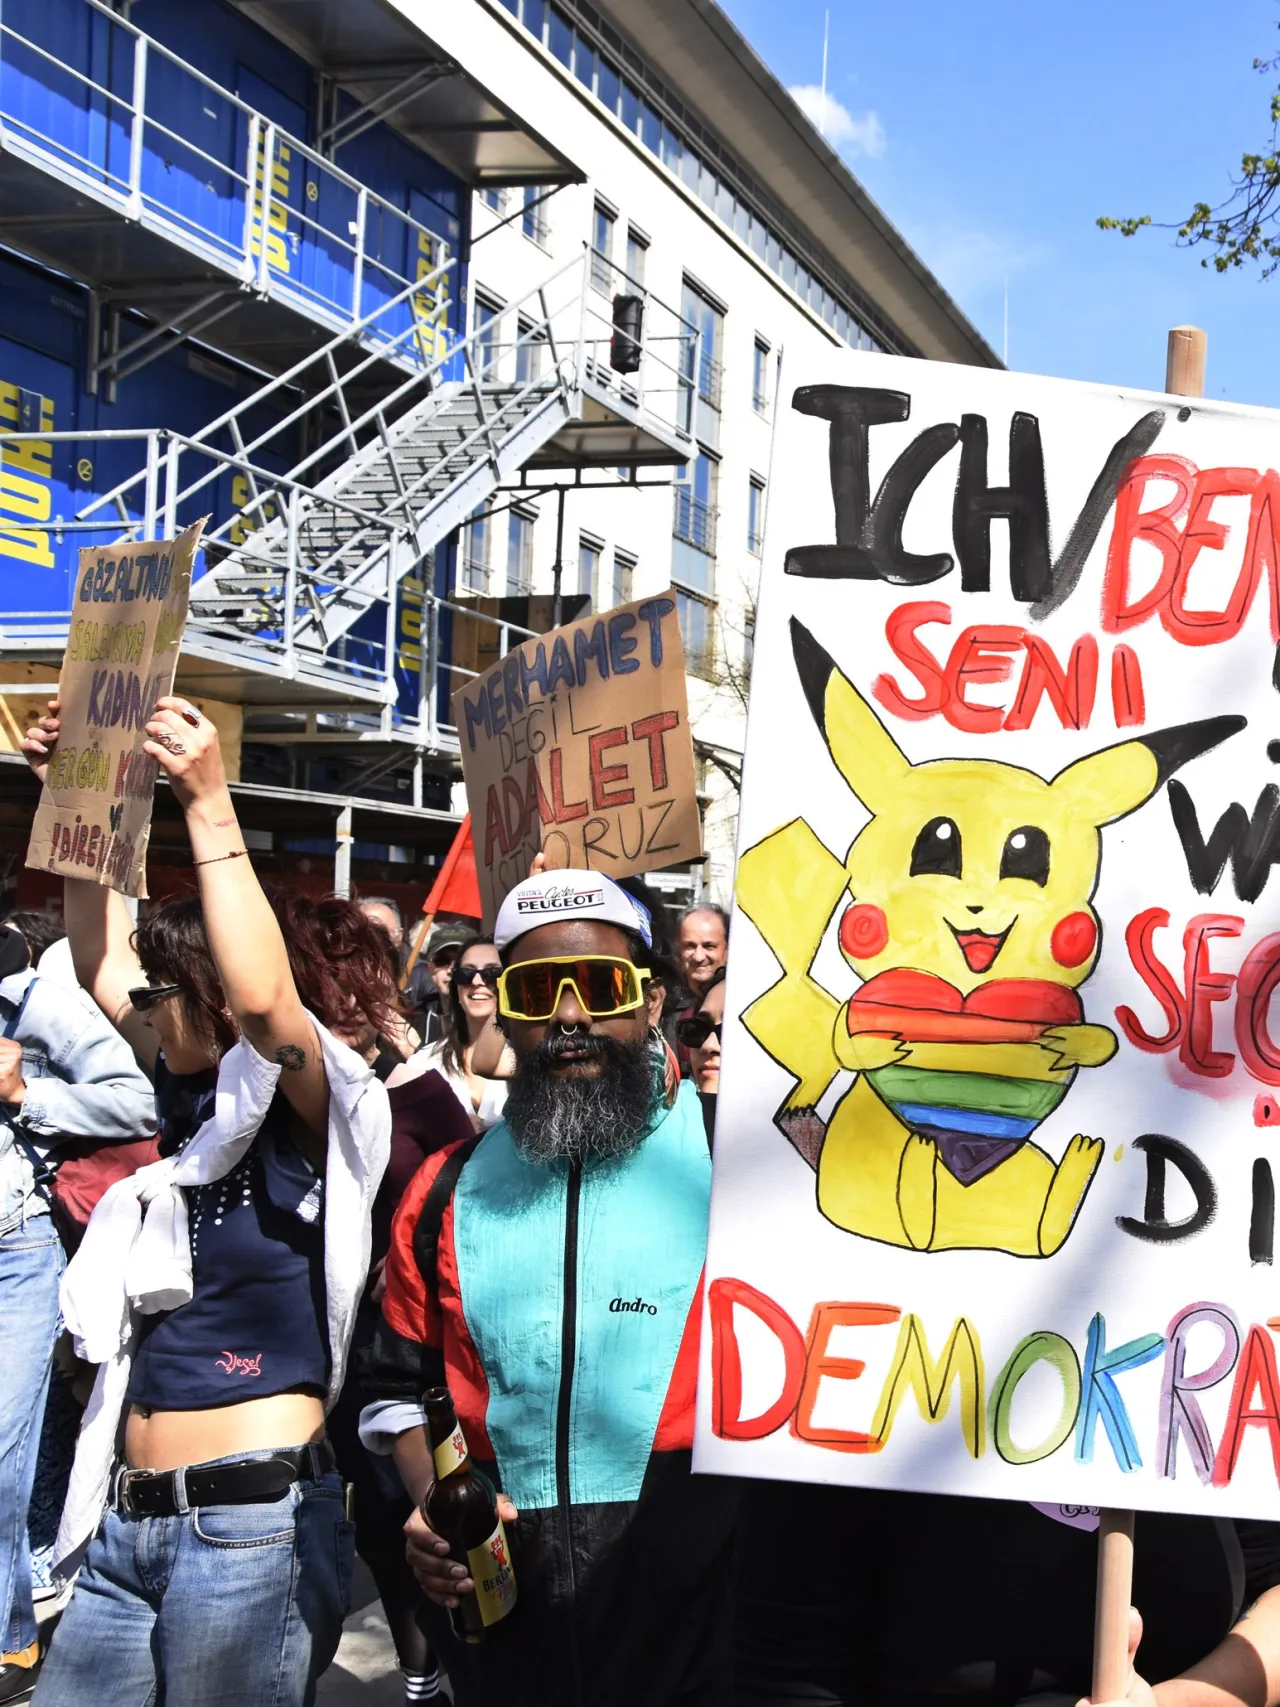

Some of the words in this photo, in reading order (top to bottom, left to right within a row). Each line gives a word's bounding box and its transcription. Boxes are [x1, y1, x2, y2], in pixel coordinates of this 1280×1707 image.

[463, 598, 676, 751] MERHAMET
[484, 710, 680, 868] ADALET
[516, 893, 596, 911] PEUGEOT
